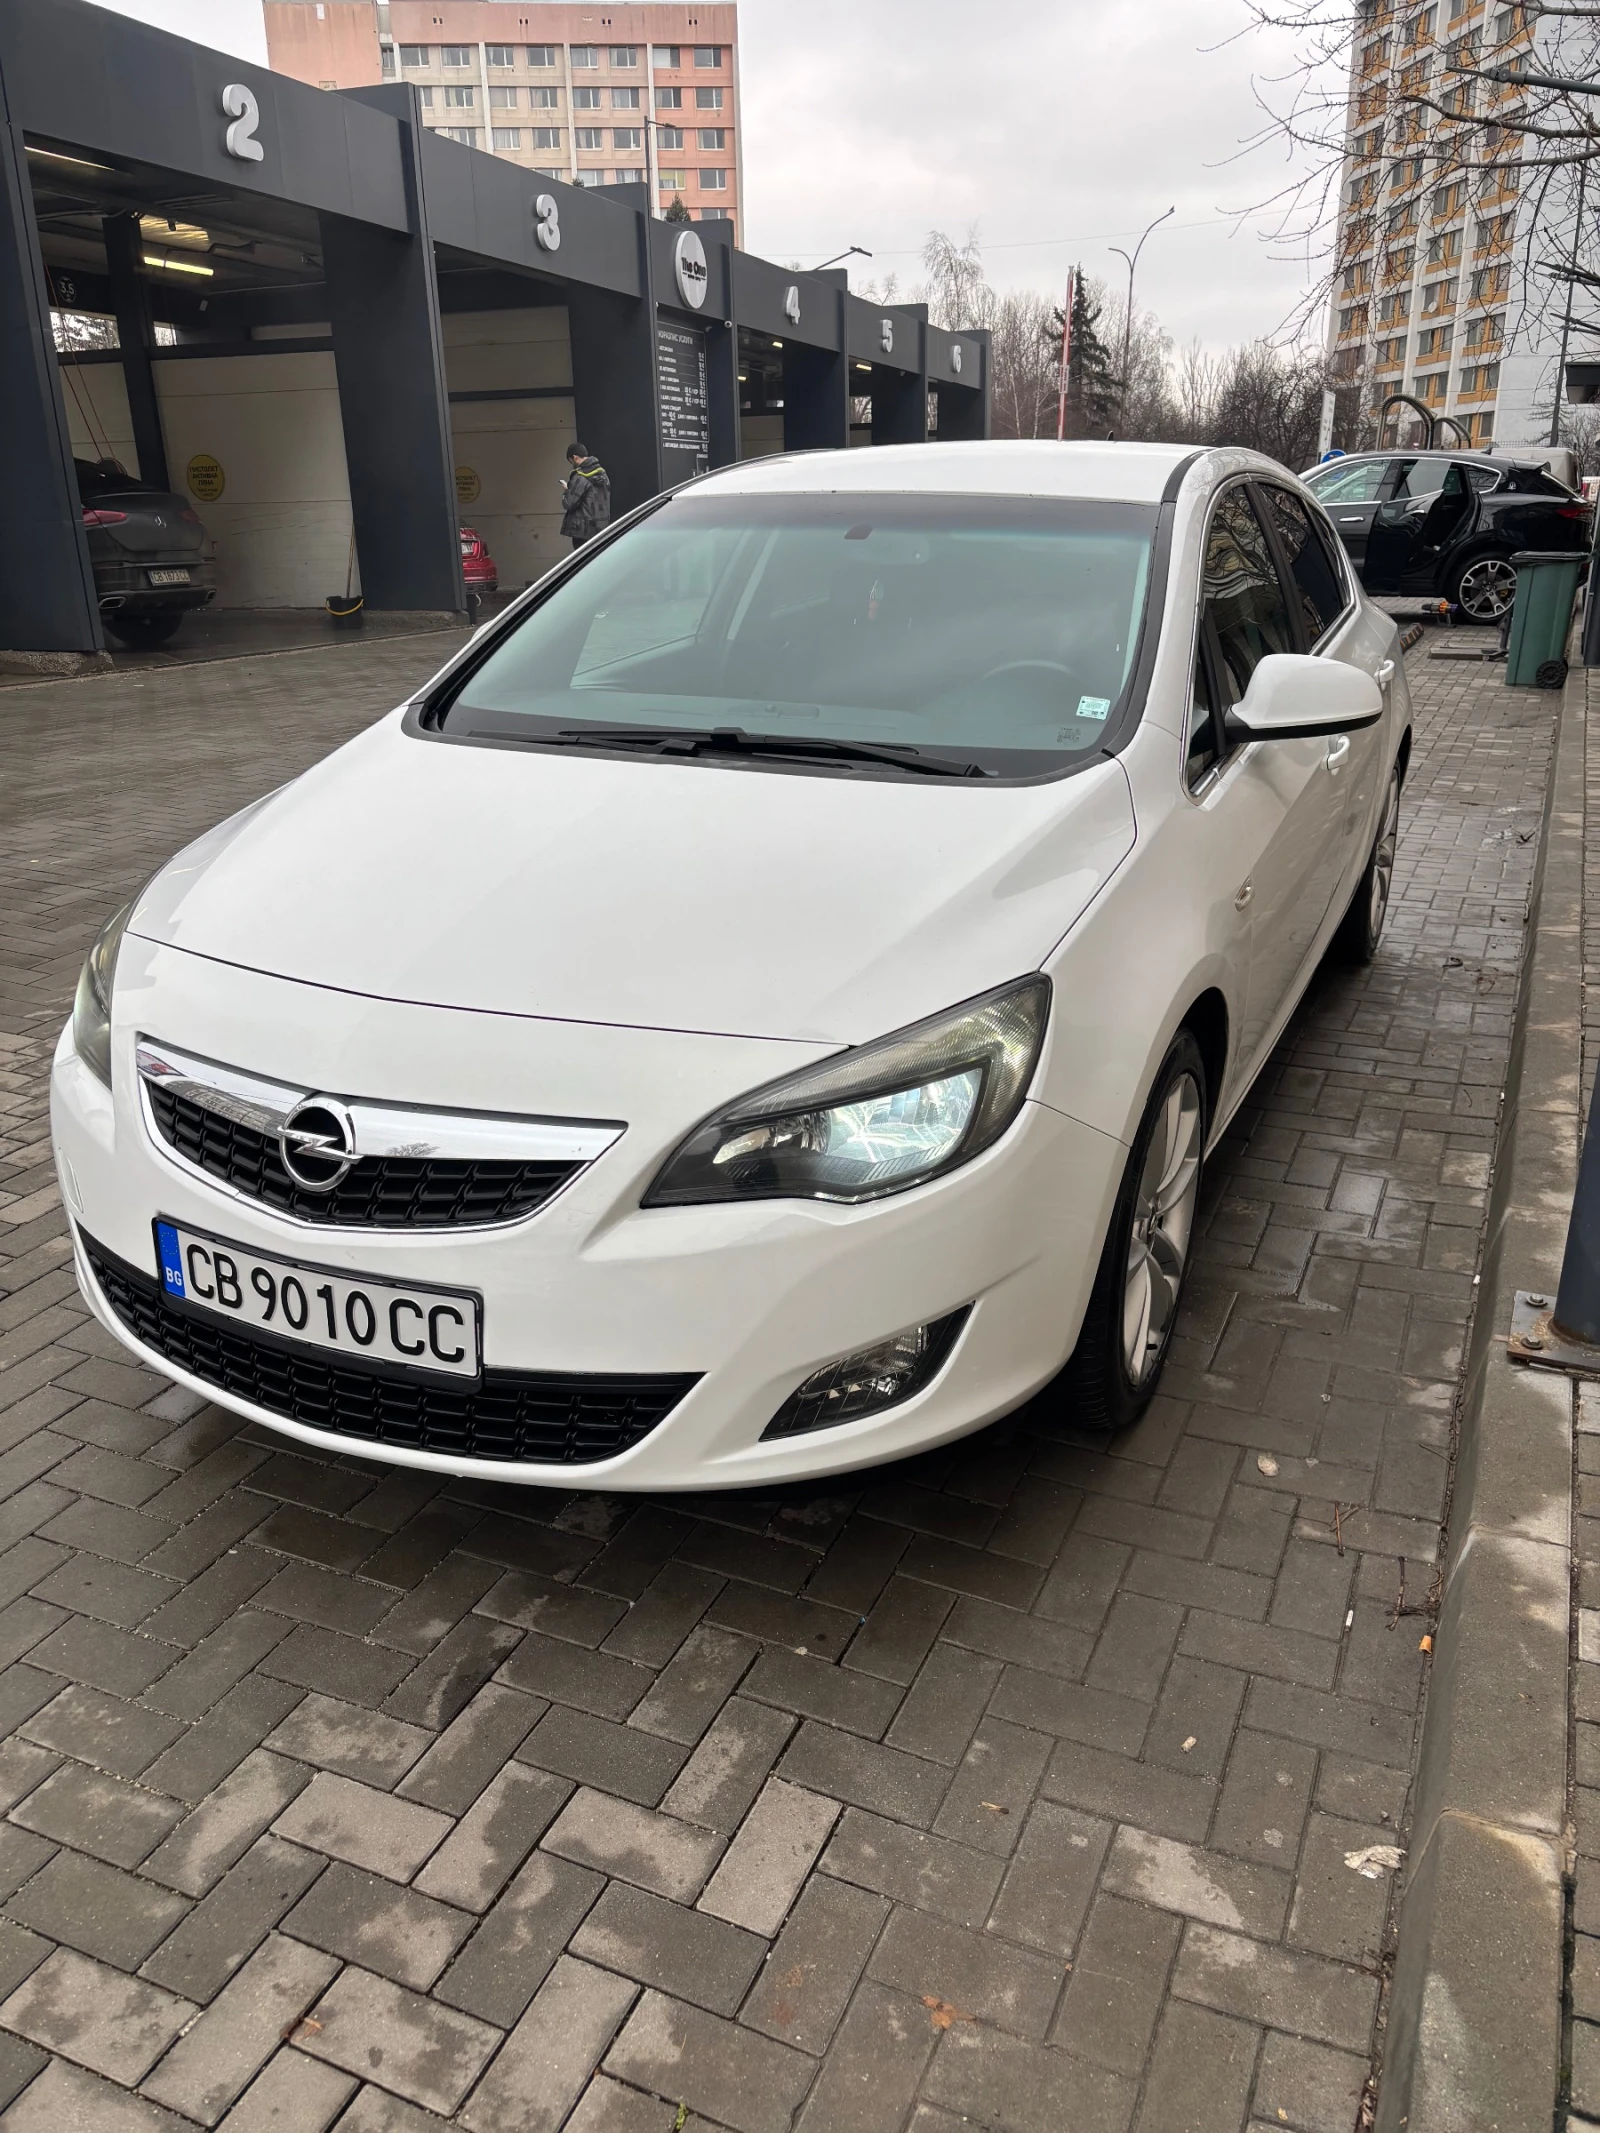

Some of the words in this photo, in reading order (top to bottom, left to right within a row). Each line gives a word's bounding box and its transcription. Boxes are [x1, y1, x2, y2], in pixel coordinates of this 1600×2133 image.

[222, 83, 264, 162] 2
[535, 193, 561, 251] 3
[681, 256, 693, 273] The
[784, 286, 802, 325] 4
[879, 319, 894, 353] 5
[950, 345, 962, 373] 6
[165, 1266, 182, 1286] BG
[186, 1243, 243, 1309] CB
[250, 1266, 376, 1346] 9010
[389, 1298, 465, 1363] CC
